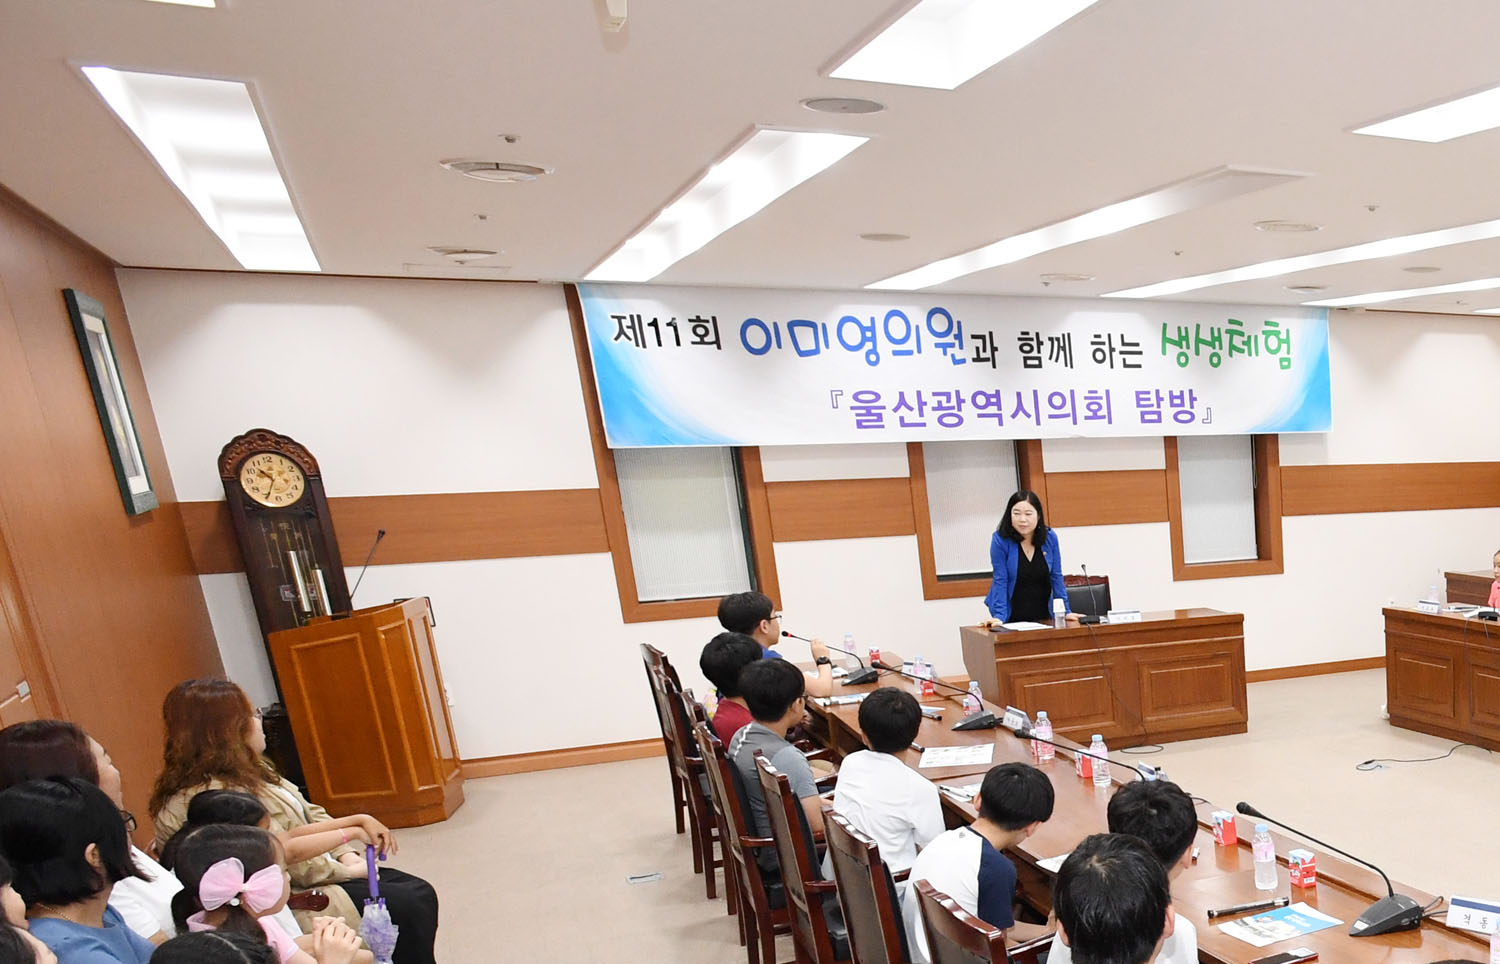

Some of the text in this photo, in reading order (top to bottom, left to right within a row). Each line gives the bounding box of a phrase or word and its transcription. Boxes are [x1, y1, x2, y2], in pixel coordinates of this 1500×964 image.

[610, 313, 722, 350] 제11회
[1017, 331, 1074, 369] 함께
[1090, 333, 1143, 369] 하는
[1161, 318, 1291, 370] 생생체험
